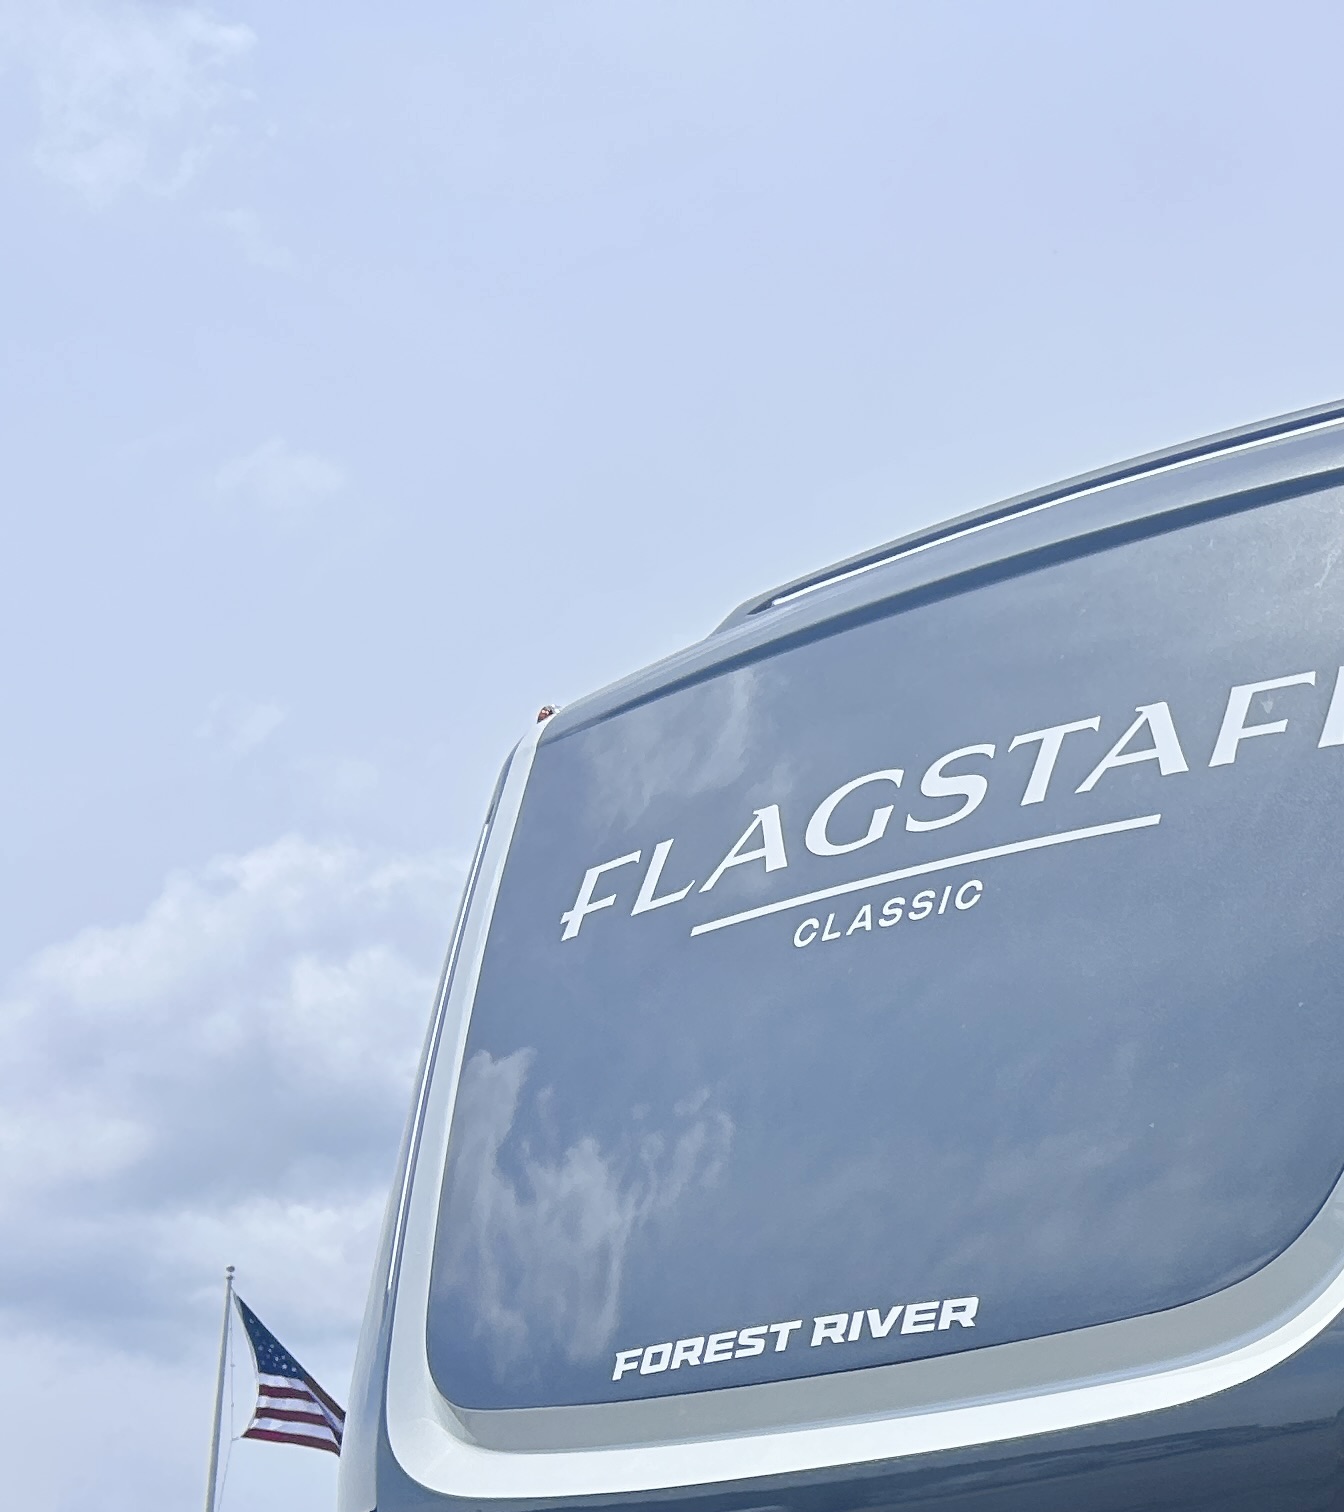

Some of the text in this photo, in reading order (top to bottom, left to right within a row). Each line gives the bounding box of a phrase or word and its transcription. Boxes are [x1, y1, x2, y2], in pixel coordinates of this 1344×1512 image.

[793, 880, 983, 948] CLASSIC
[612, 1297, 979, 1381] FOREST RIVER
